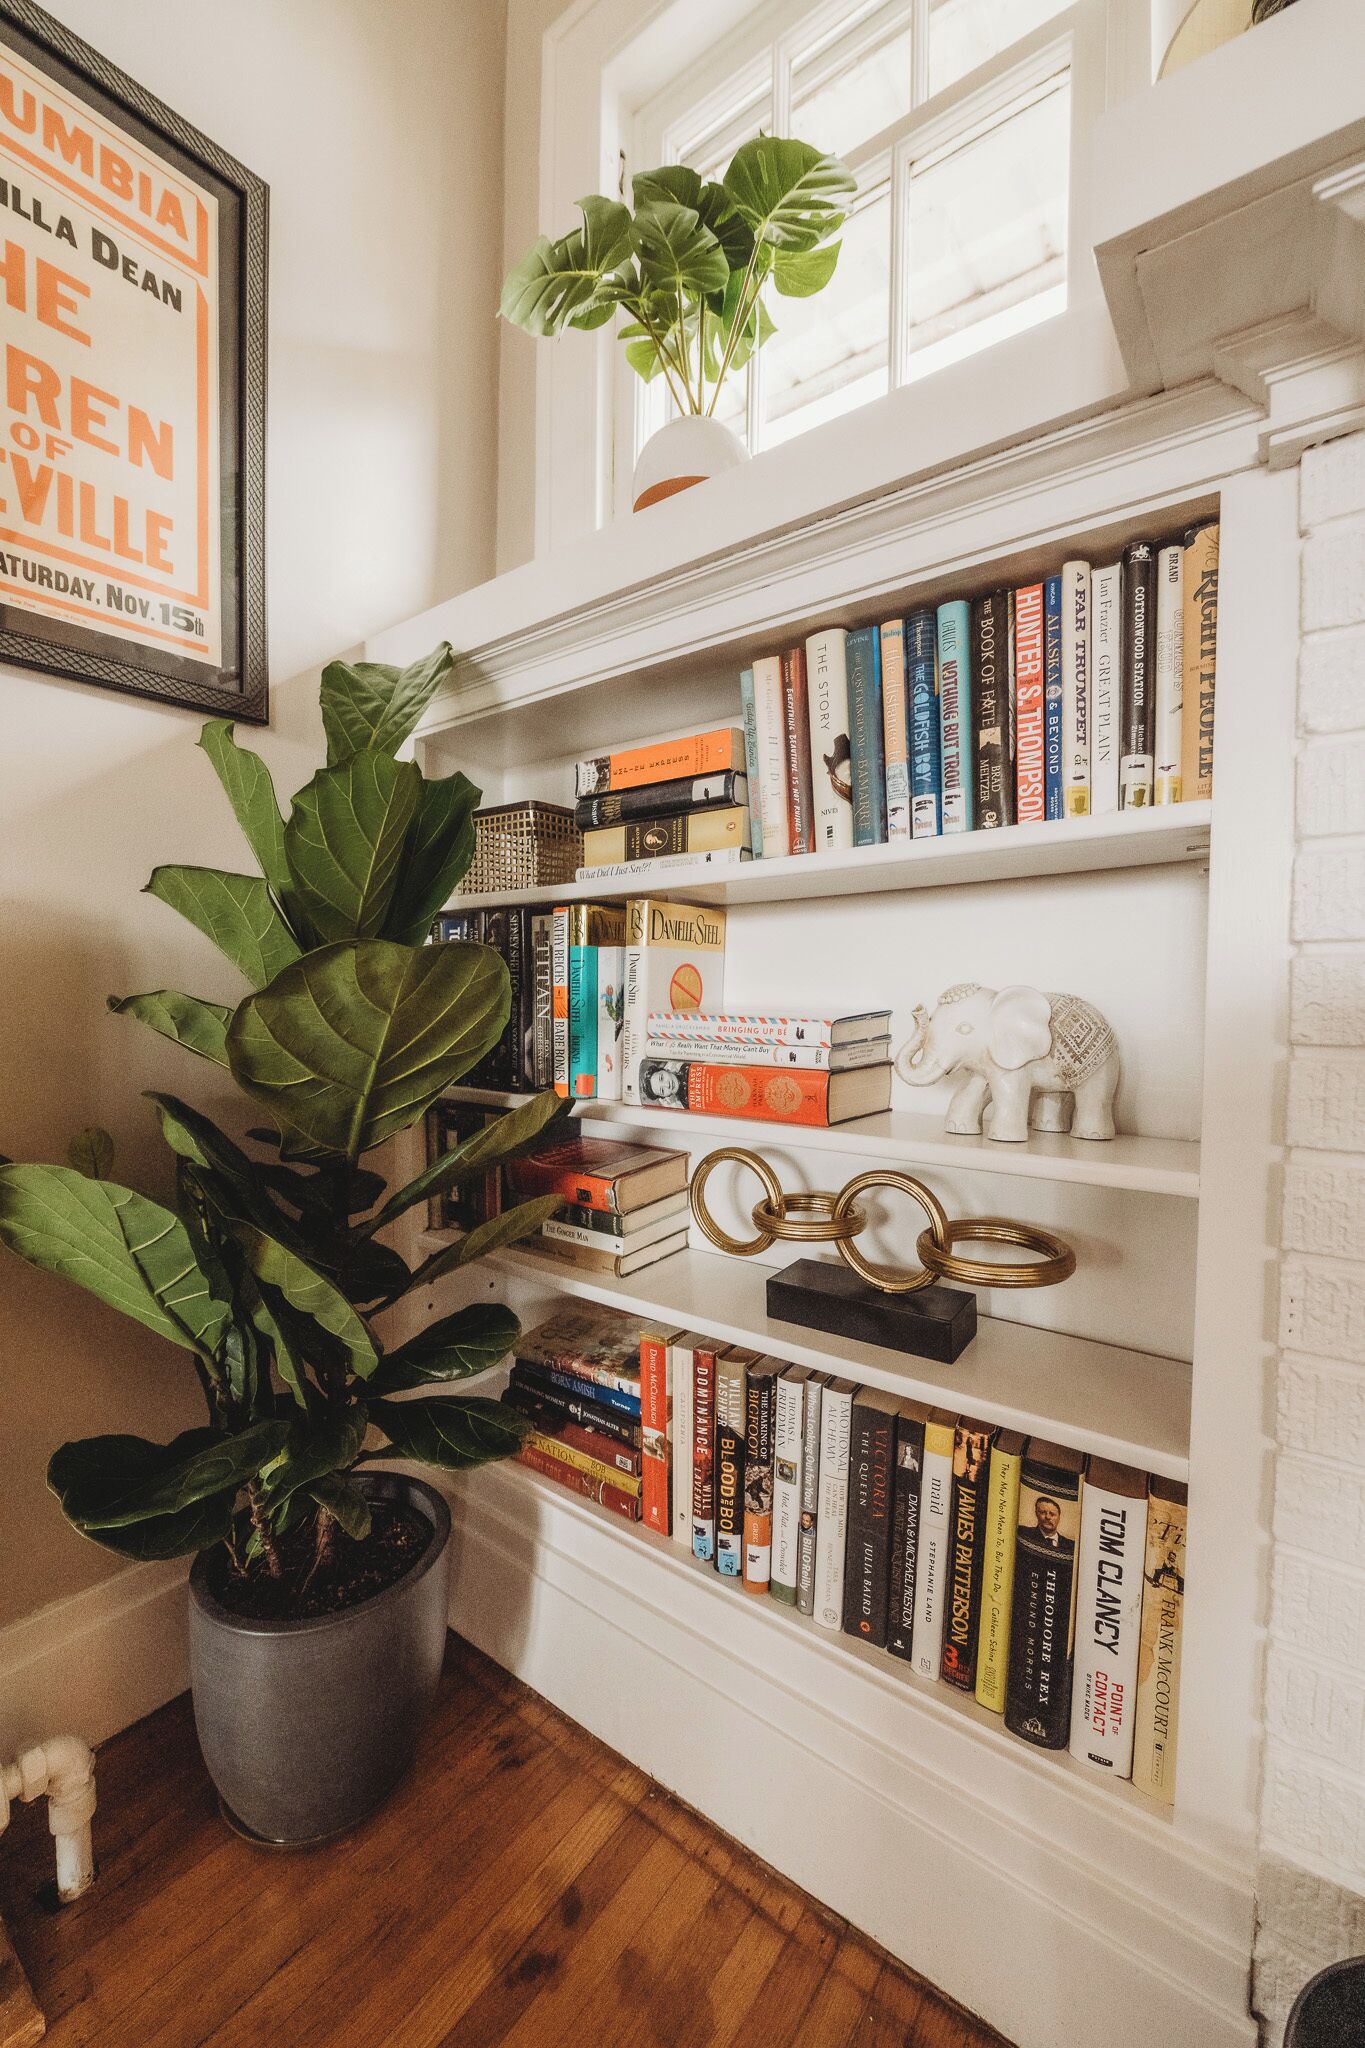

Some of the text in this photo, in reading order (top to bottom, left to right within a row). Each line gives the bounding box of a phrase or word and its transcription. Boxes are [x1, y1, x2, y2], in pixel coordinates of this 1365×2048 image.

[0, 72, 189, 242] UMBIA
[92, 226, 183, 314] DEAN
[6, 343, 174, 482] REN
[10, 421, 74, 462] OF
[0, 447, 174, 576] VILLE
[1075, 571, 1085, 584] A
[1168, 552, 1179, 583] BRAND
[106, 582, 155, 622] NOV.
[159, 602, 204, 638] 15th
[941, 620, 957, 653] DAVIES
[1016, 589, 1041, 678] HUNTER
[1075, 588, 1086, 633] FAR
[1099, 576, 1112, 644] Ian Frazier
[1193, 569, 1218, 661] RIGHT
[885, 648, 901, 674] the
[980, 598, 997, 728] THE BOOK OF FATE
[1133, 586, 1145, 706] COTTONWOOD STATION
[817, 643, 830, 730] THE STORY
[941, 659, 959, 722] NOTHING
[1017, 684, 1042, 707] S.
[1047, 614, 1060, 775] ALASKA & BEYOND
[1075, 640, 1087, 746] TRUMPET
[1098, 654, 1111, 707] GREAT
[886, 679, 903, 746] distance
[913, 663, 932, 782] THE GOLDFISH BOY
[943, 722, 960, 750] BUT
[1198, 671, 1216, 779] PEOPLE
[613, 754, 690, 776] EMPIRE EXPRESS
[786, 687, 803, 833] EVERYTHING BEAUTIFUL IS NOT RUINED
[979, 758, 990, 803] MELTZER
[991, 765, 1001, 793] BRAD
[1017, 706, 1043, 825] THOMPSON
[854, 759, 872, 831] BAMARRE
[578, 864, 609, 881] What Did
[509, 914, 519, 950] SIDNEY
[553, 915, 565, 984] KATHY REICHS
[652, 908, 722, 946] DANIELLE STEEL
[536, 940, 552, 1021] TITAN
[570, 959, 585, 998] DANIELLE
[628, 953, 641, 983] DANIELLE
[554, 1021, 566, 1082] BARE BONES
[677, 1042, 692, 1050] Really
[723, 1045, 742, 1053] Money
[743, 1045, 757, 1053] Can't
[758, 1046, 770, 1054] Buy
[717, 1026, 760, 1035] BRINGING
[695, 1066, 703, 1108] EMPRESS
[556, 1226, 589, 1243] GINGER MAN
[551, 1372, 571, 1390] BORN
[572, 1381, 596, 1399] AMISH
[649, 1348, 658, 1372] DAVID
[582, 1410, 620, 1432] JONATHAN ALTER
[611, 1399, 631, 1412] Turner
[696, 1366, 709, 1455] DOMINANCE
[717, 1374, 728, 1427] LASHNER
[728, 1379, 741, 1428] WILLIAM
[747, 1388, 759, 1458] BIGFOOT
[760, 1390, 769, 1461] THE MAKING OF
[777, 1386, 787, 1449] FRIEDMAN
[787, 1395, 797, 1437] THOMAS
[538, 1440, 576, 1464] NATION
[804, 1419, 816, 1509] Looking Out for You?
[825, 1405, 838, 1465] ALCHEMY
[837, 1400, 850, 1474] EMOTIONAL
[590, 1461, 606, 1475] BOB
[702, 1484, 712, 1511] WILL
[720, 1437, 735, 1507] BLOOD and
[858, 1431, 870, 1507] THE QUEEN
[872, 1429, 888, 1518] VICTORIA
[930, 1477, 944, 1516] maid
[779, 1540, 789, 1576] Crowded
[802, 1537, 812, 1555] Bill
[993, 1462, 1010, 1594] They May Not Mean But They Do
[862, 1542, 873, 1615] JULIA BAIRD
[902, 1493, 918, 1630] DIANA & MICHAEL PRESTON
[925, 1540, 937, 1623] STEPHANIE LAND
[951, 1483, 977, 1646] JAMES PATTERSON
[1093, 1507, 1127, 1656] TOM CLANCY
[988, 1639, 998, 1663] Schine
[990, 1606, 1000, 1638] Cathleen
[1024, 1571, 1039, 1691] EDMUND MORRIS
[1039, 1570, 1057, 1706] THEODORE REX
[1158, 1598, 1177, 1658] FRANK
[1086, 1672, 1092, 1681] BY
[1092, 1670, 1109, 1737] CONTACT
[1109, 1682, 1124, 1736] POINT OF
